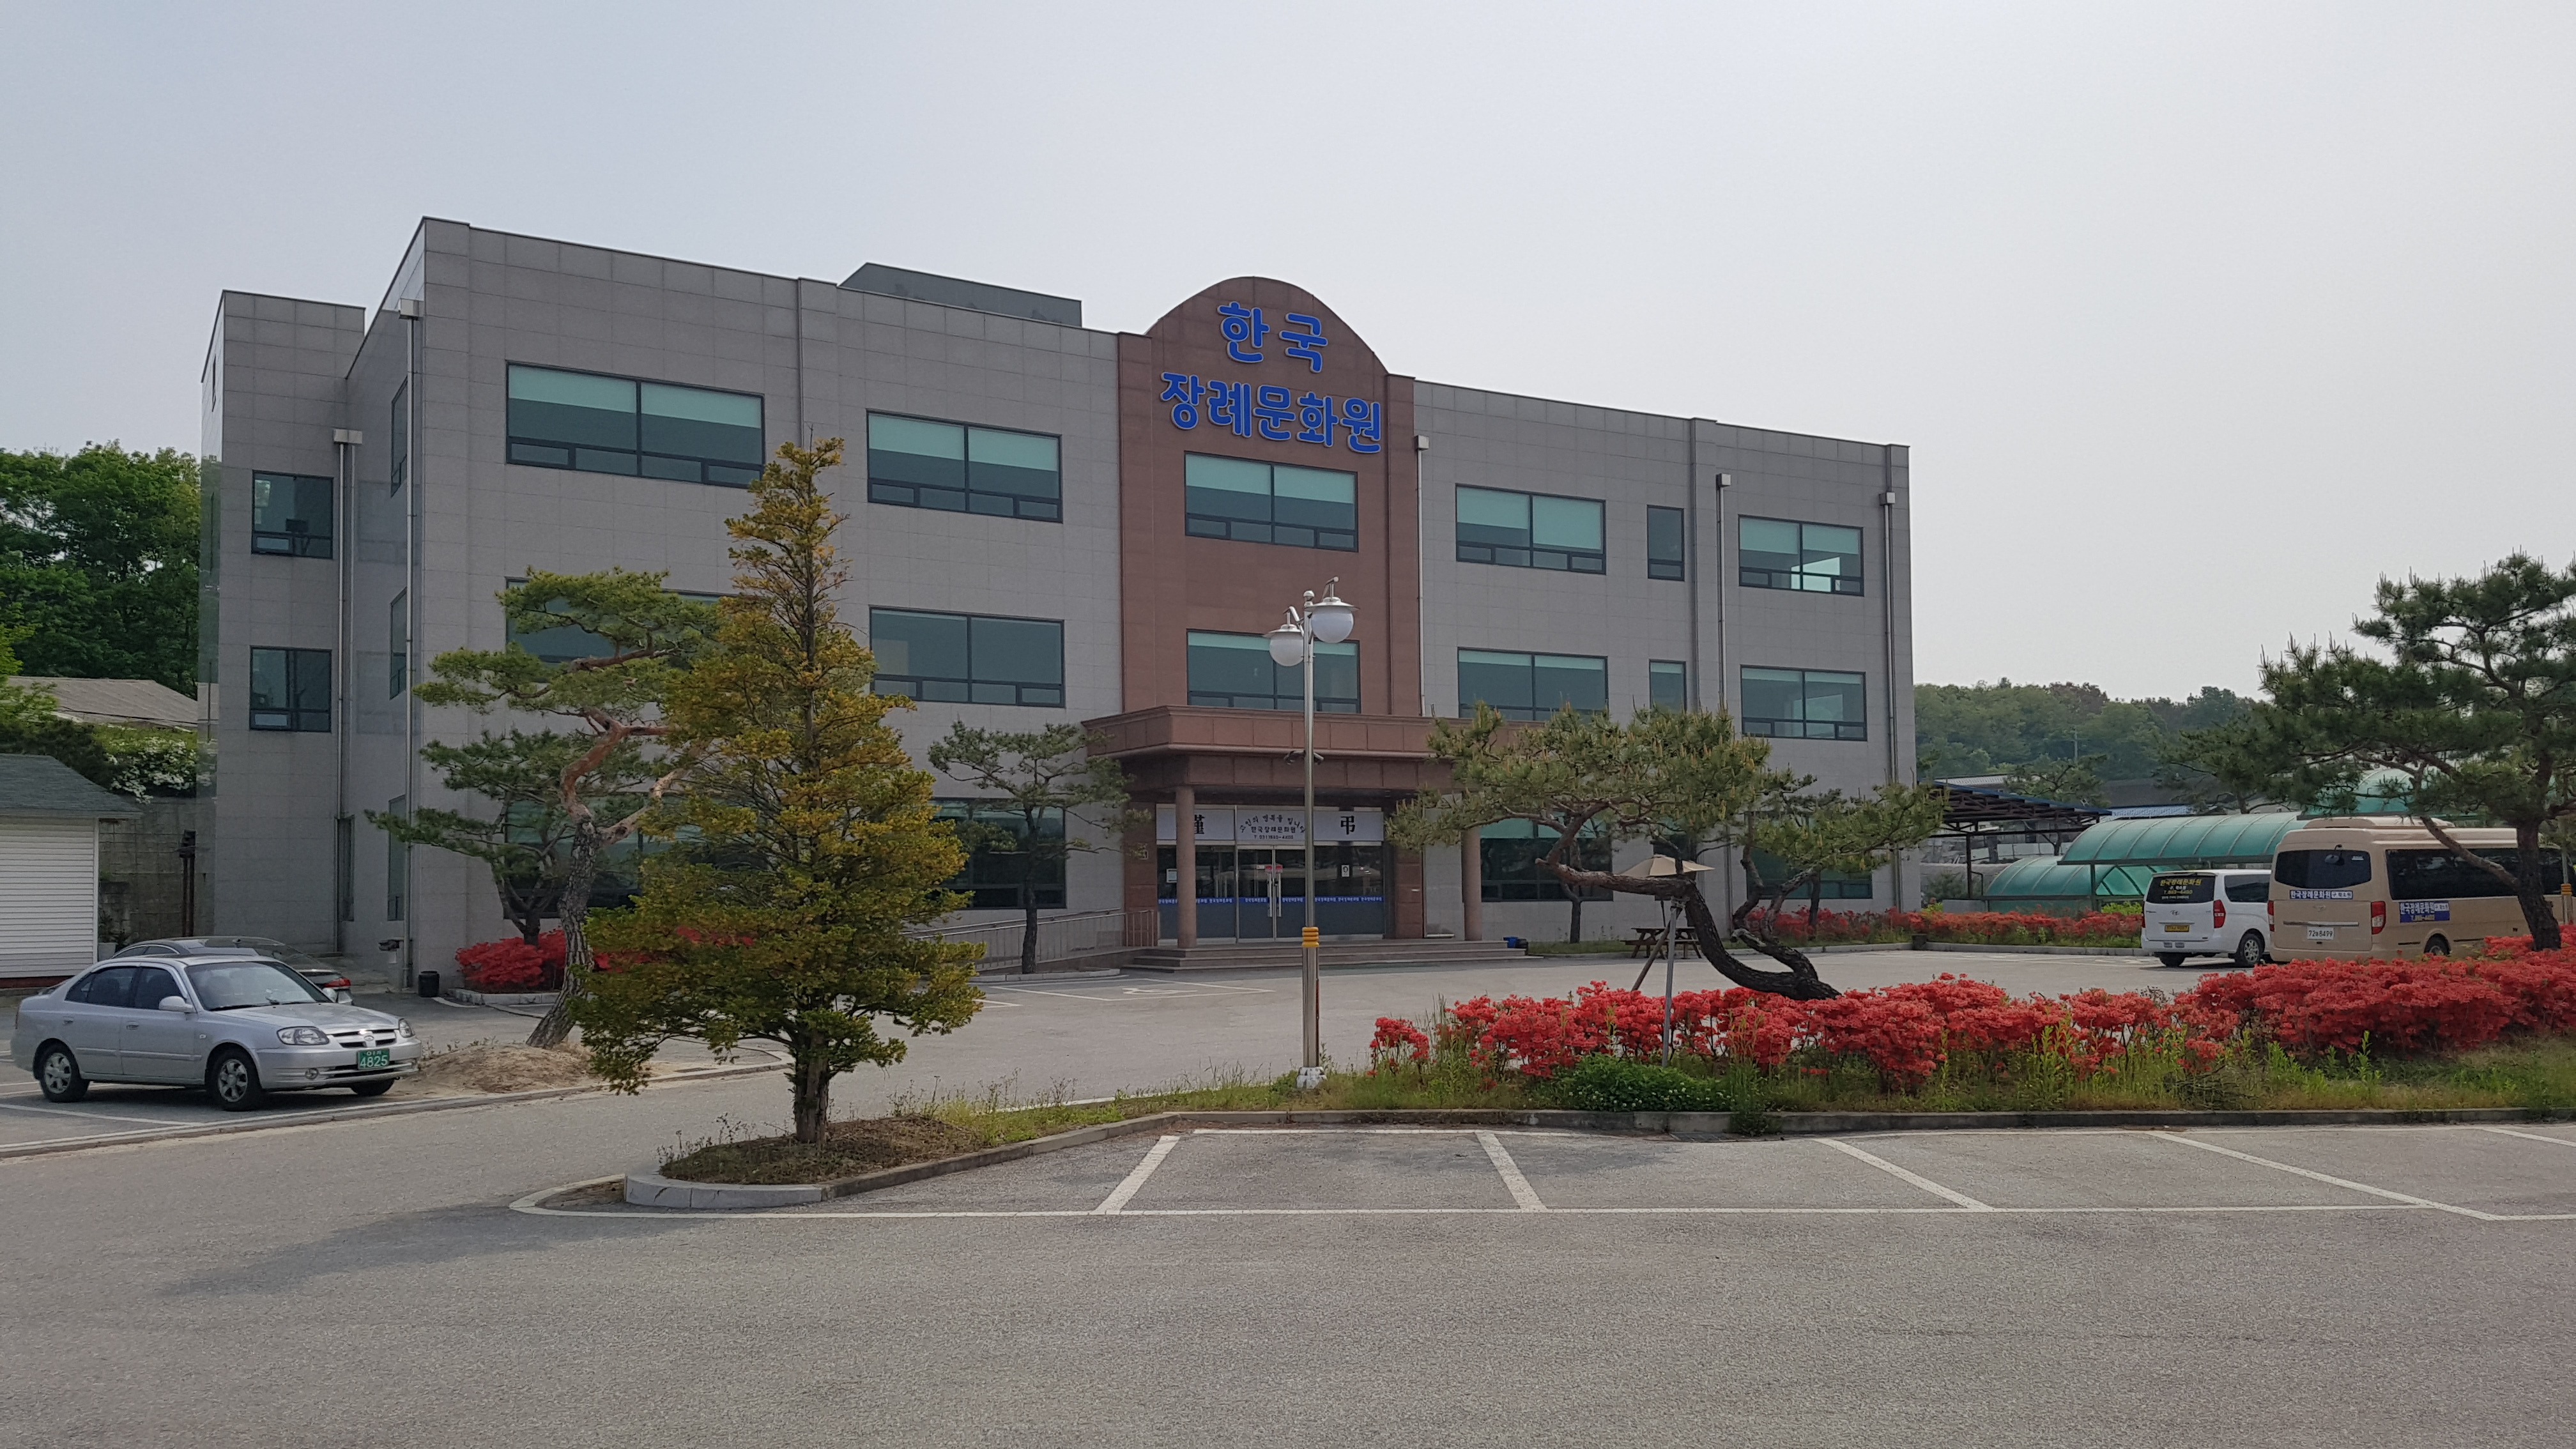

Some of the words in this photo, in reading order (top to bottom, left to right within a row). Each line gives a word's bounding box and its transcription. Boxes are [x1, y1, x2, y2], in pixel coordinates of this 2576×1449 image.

[1216, 301, 1328, 373] 한국
[1160, 371, 1382, 454] 장례문화원
[1262, 814, 1283, 823] 명복을
[1340, 815, 1356, 835] 弔
[2290, 890, 2331, 899] 한국장례문화원
[2400, 902, 2435, 915] 한국장례문화원
[360, 1055, 388, 1068] 4825
